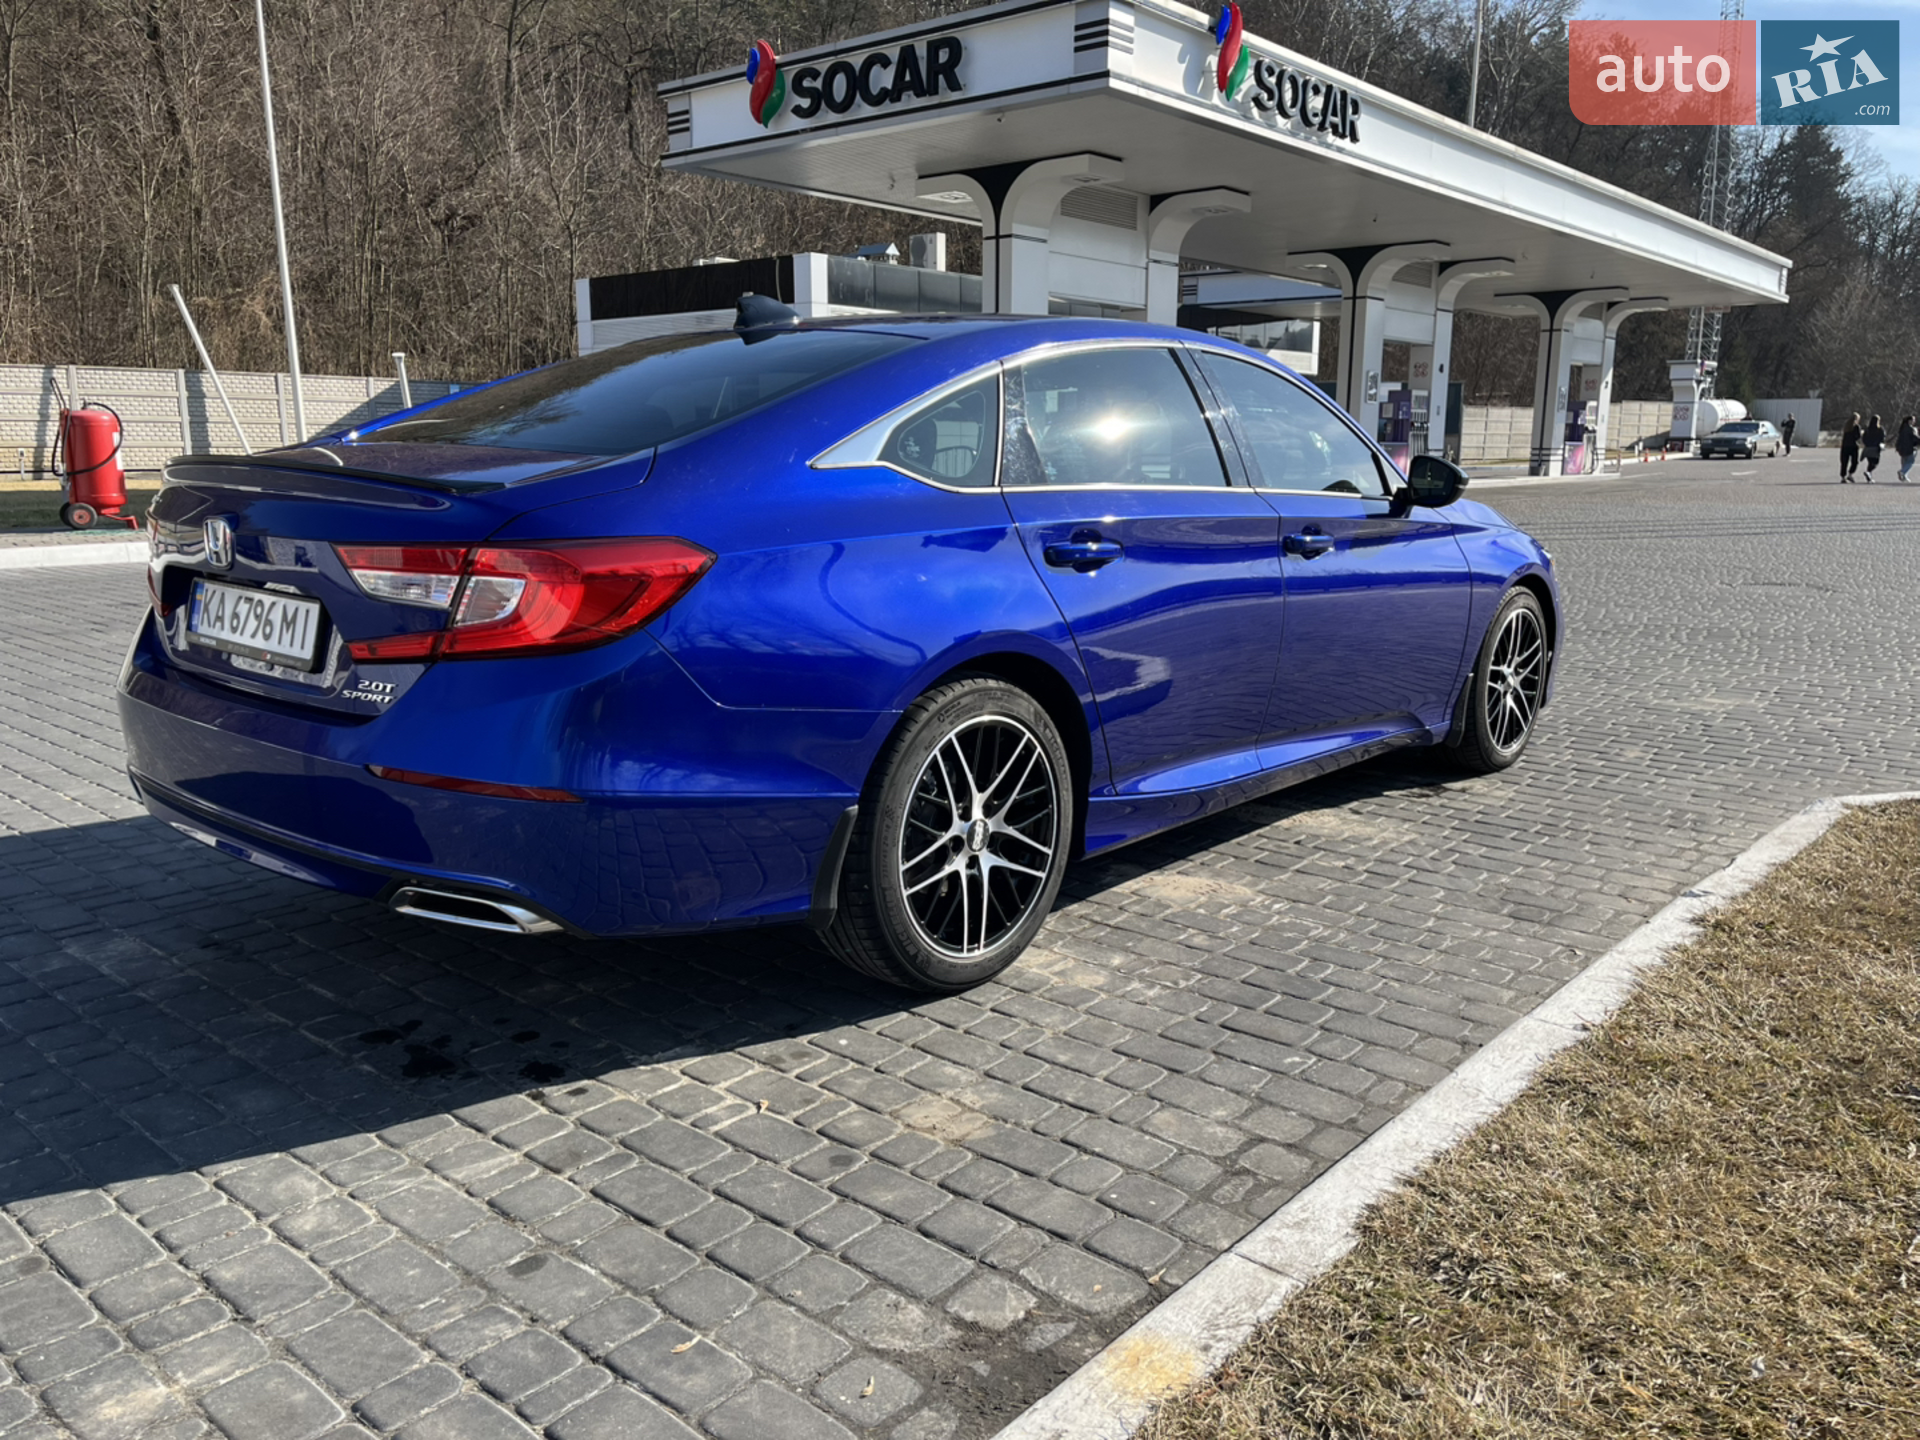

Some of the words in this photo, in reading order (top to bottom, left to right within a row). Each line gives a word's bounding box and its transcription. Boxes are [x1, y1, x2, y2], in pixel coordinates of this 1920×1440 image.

[790, 35, 964, 119] SOCAR
[1251, 57, 1361, 144] SOCAR
[201, 588, 225, 631] KA
[229, 595, 277, 642] 6796
[277, 603, 310, 650] MI
[341, 689, 395, 704] SPORT
[357, 679, 397, 693] 2.0T
[882, 886, 918, 959] MICHELIN
